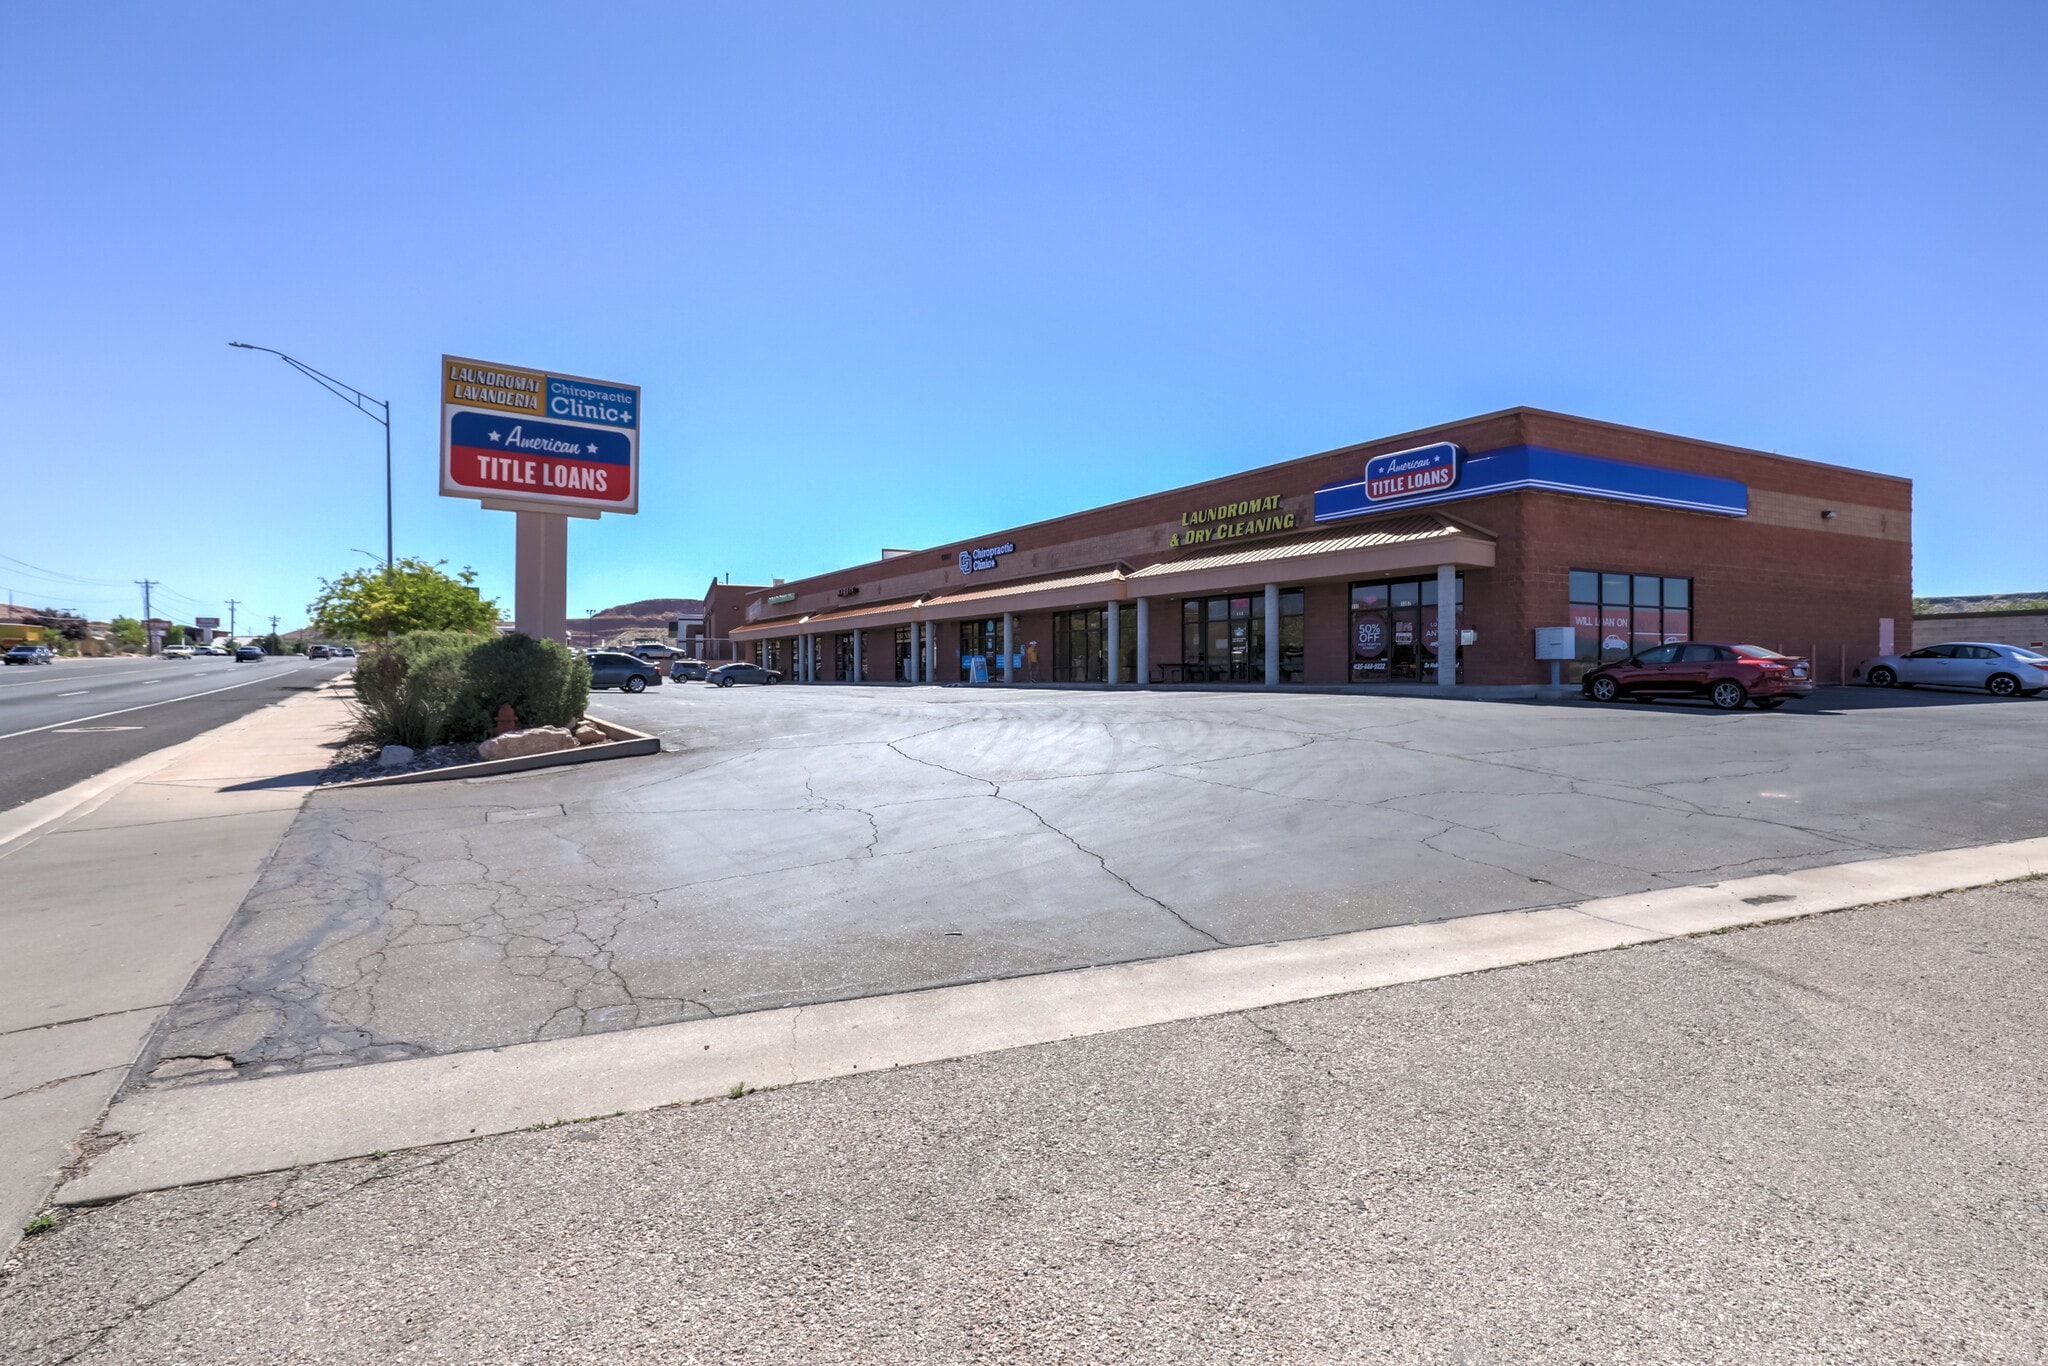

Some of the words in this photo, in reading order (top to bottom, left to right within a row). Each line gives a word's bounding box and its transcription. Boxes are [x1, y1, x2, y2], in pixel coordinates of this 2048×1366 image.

[450, 366, 542, 393] LAUNDROMAT
[454, 384, 538, 409] LAVANDERIA
[551, 382, 632, 404] Chiropractic
[505, 425, 581, 455] American
[477, 455, 536, 484] TITLE
[543, 463, 608, 492] LOANS
[1387, 459, 1430, 474] American
[1371, 477, 1404, 496] TITLE
[1407, 468, 1449, 489] LOANS
[1181, 494, 1281, 526] LAUNDROMAT
[1169, 532, 1180, 547] &
[1184, 528, 1213, 545] DRY
[1216, 513, 1295, 539] CLEANING
[973, 542, 1014, 559] Chiropractic
[1359, 623, 1381, 634] 50%
[1575, 616, 1593, 626] WILL
[1616, 617, 1628, 628] ON
[1359, 633, 1381, 642] OFF
